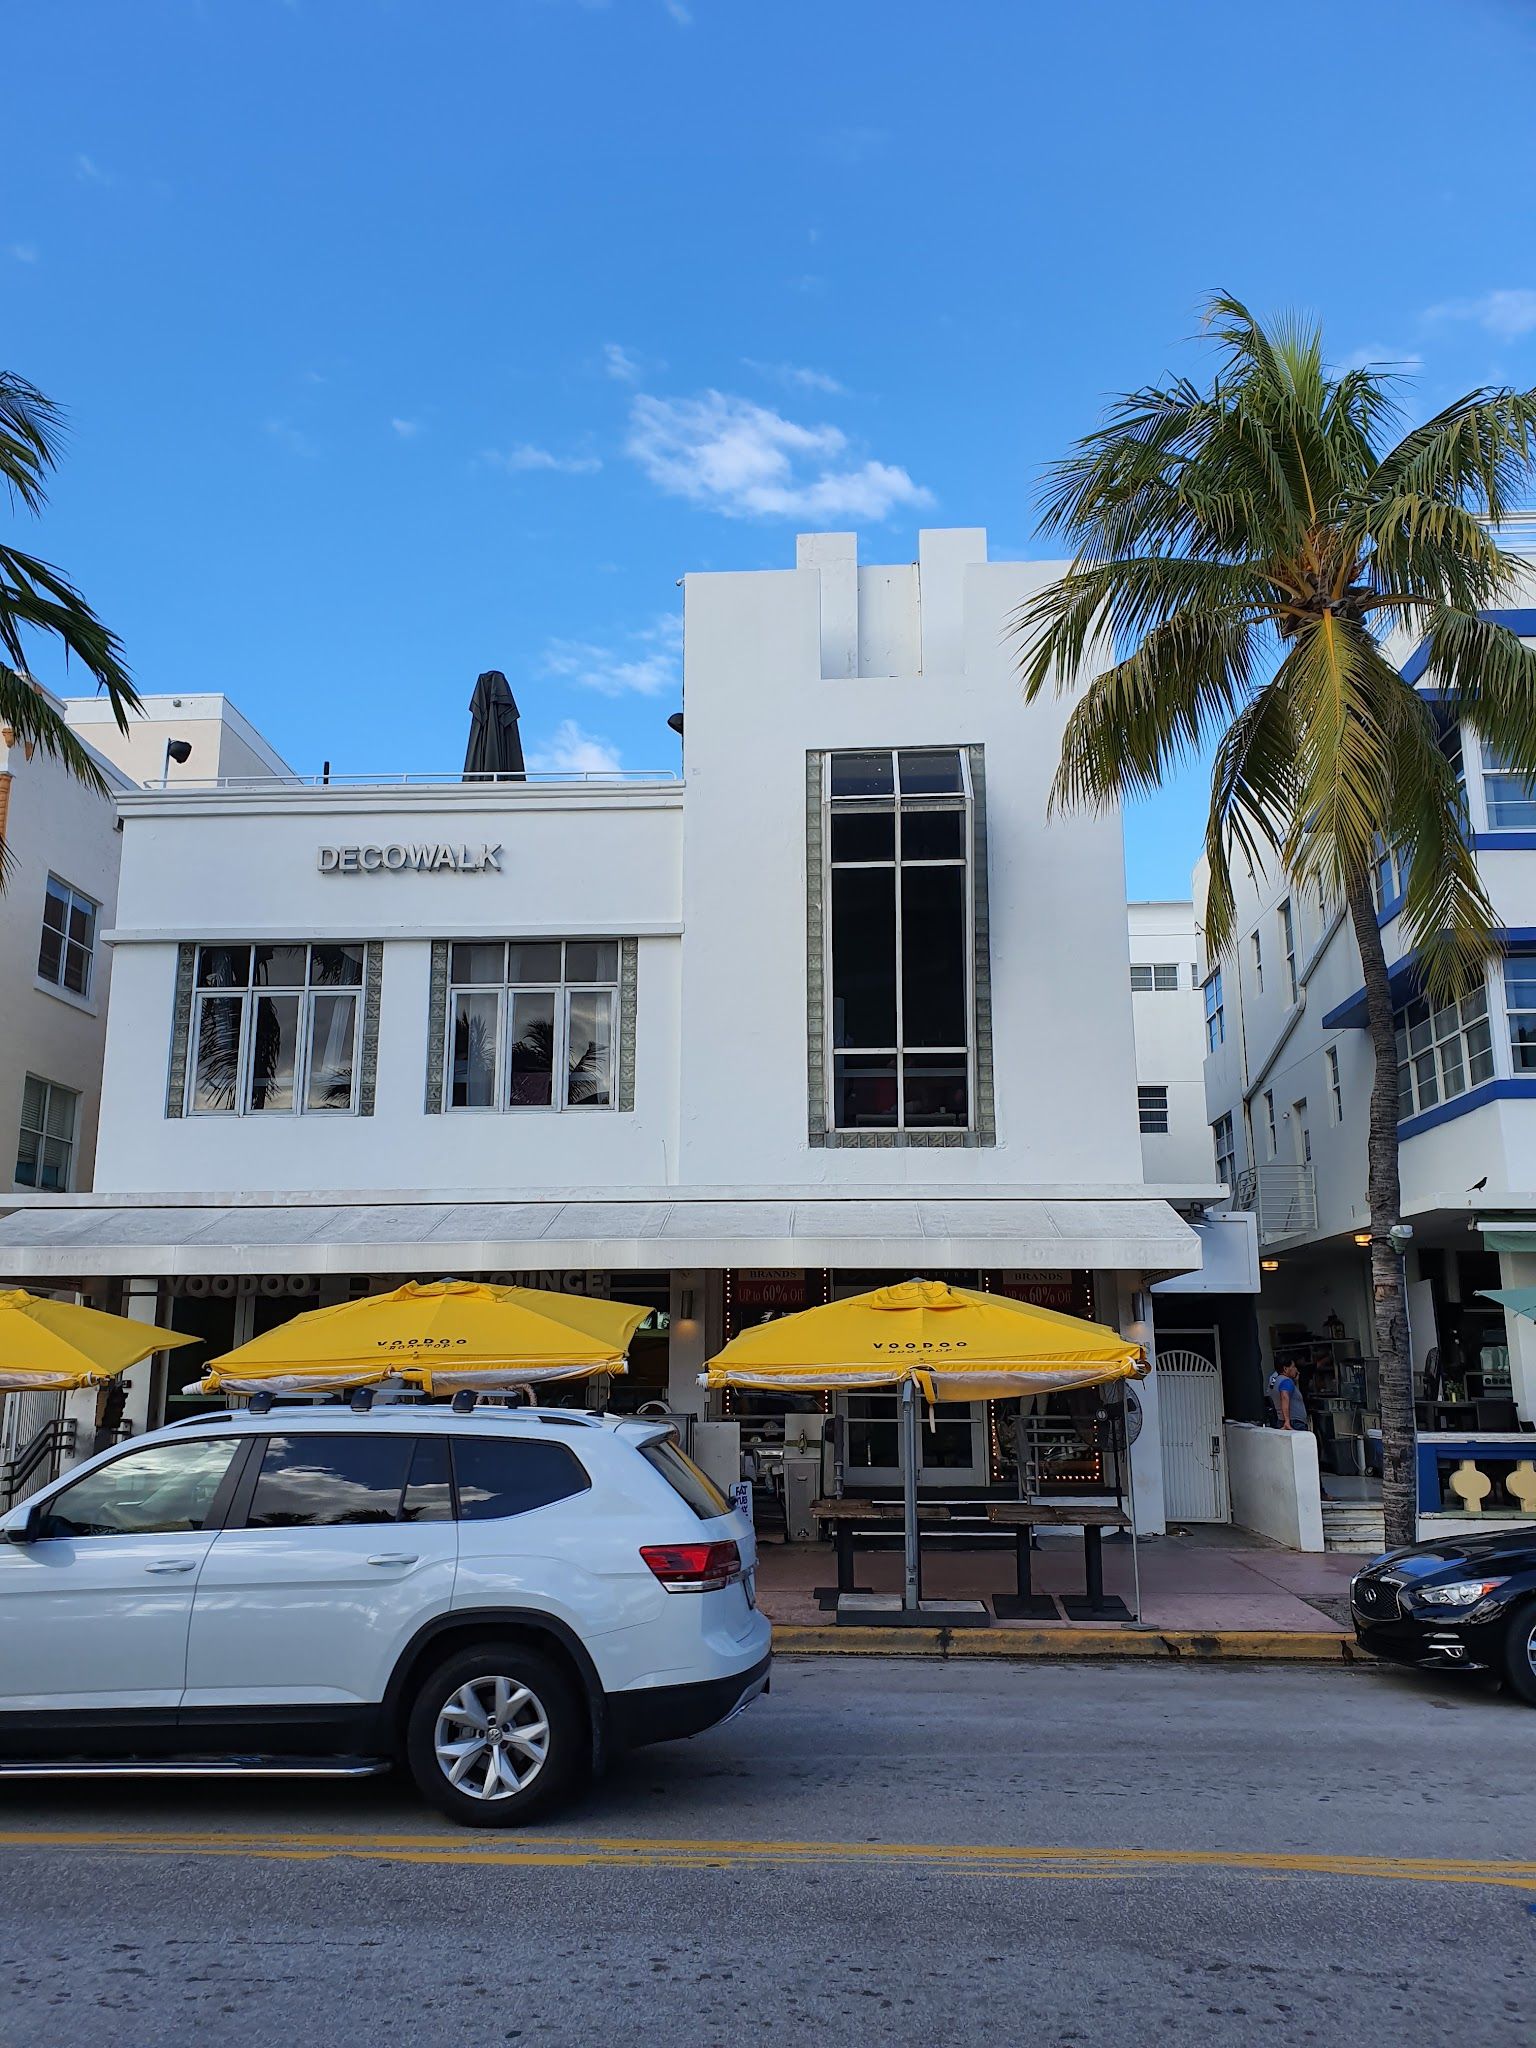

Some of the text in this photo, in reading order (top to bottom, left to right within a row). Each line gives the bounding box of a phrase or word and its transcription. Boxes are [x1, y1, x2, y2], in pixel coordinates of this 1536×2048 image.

[317, 844, 501, 871] DECOWALK
[750, 1270, 797, 1278] BRANDS
[165, 1275, 310, 1298] VOODOO
[763, 1284, 788, 1302] 60%
[1030, 1286, 1055, 1303] 60%
[377, 1338, 467, 1346] VOODOO
[873, 1341, 967, 1349] VOODOO
